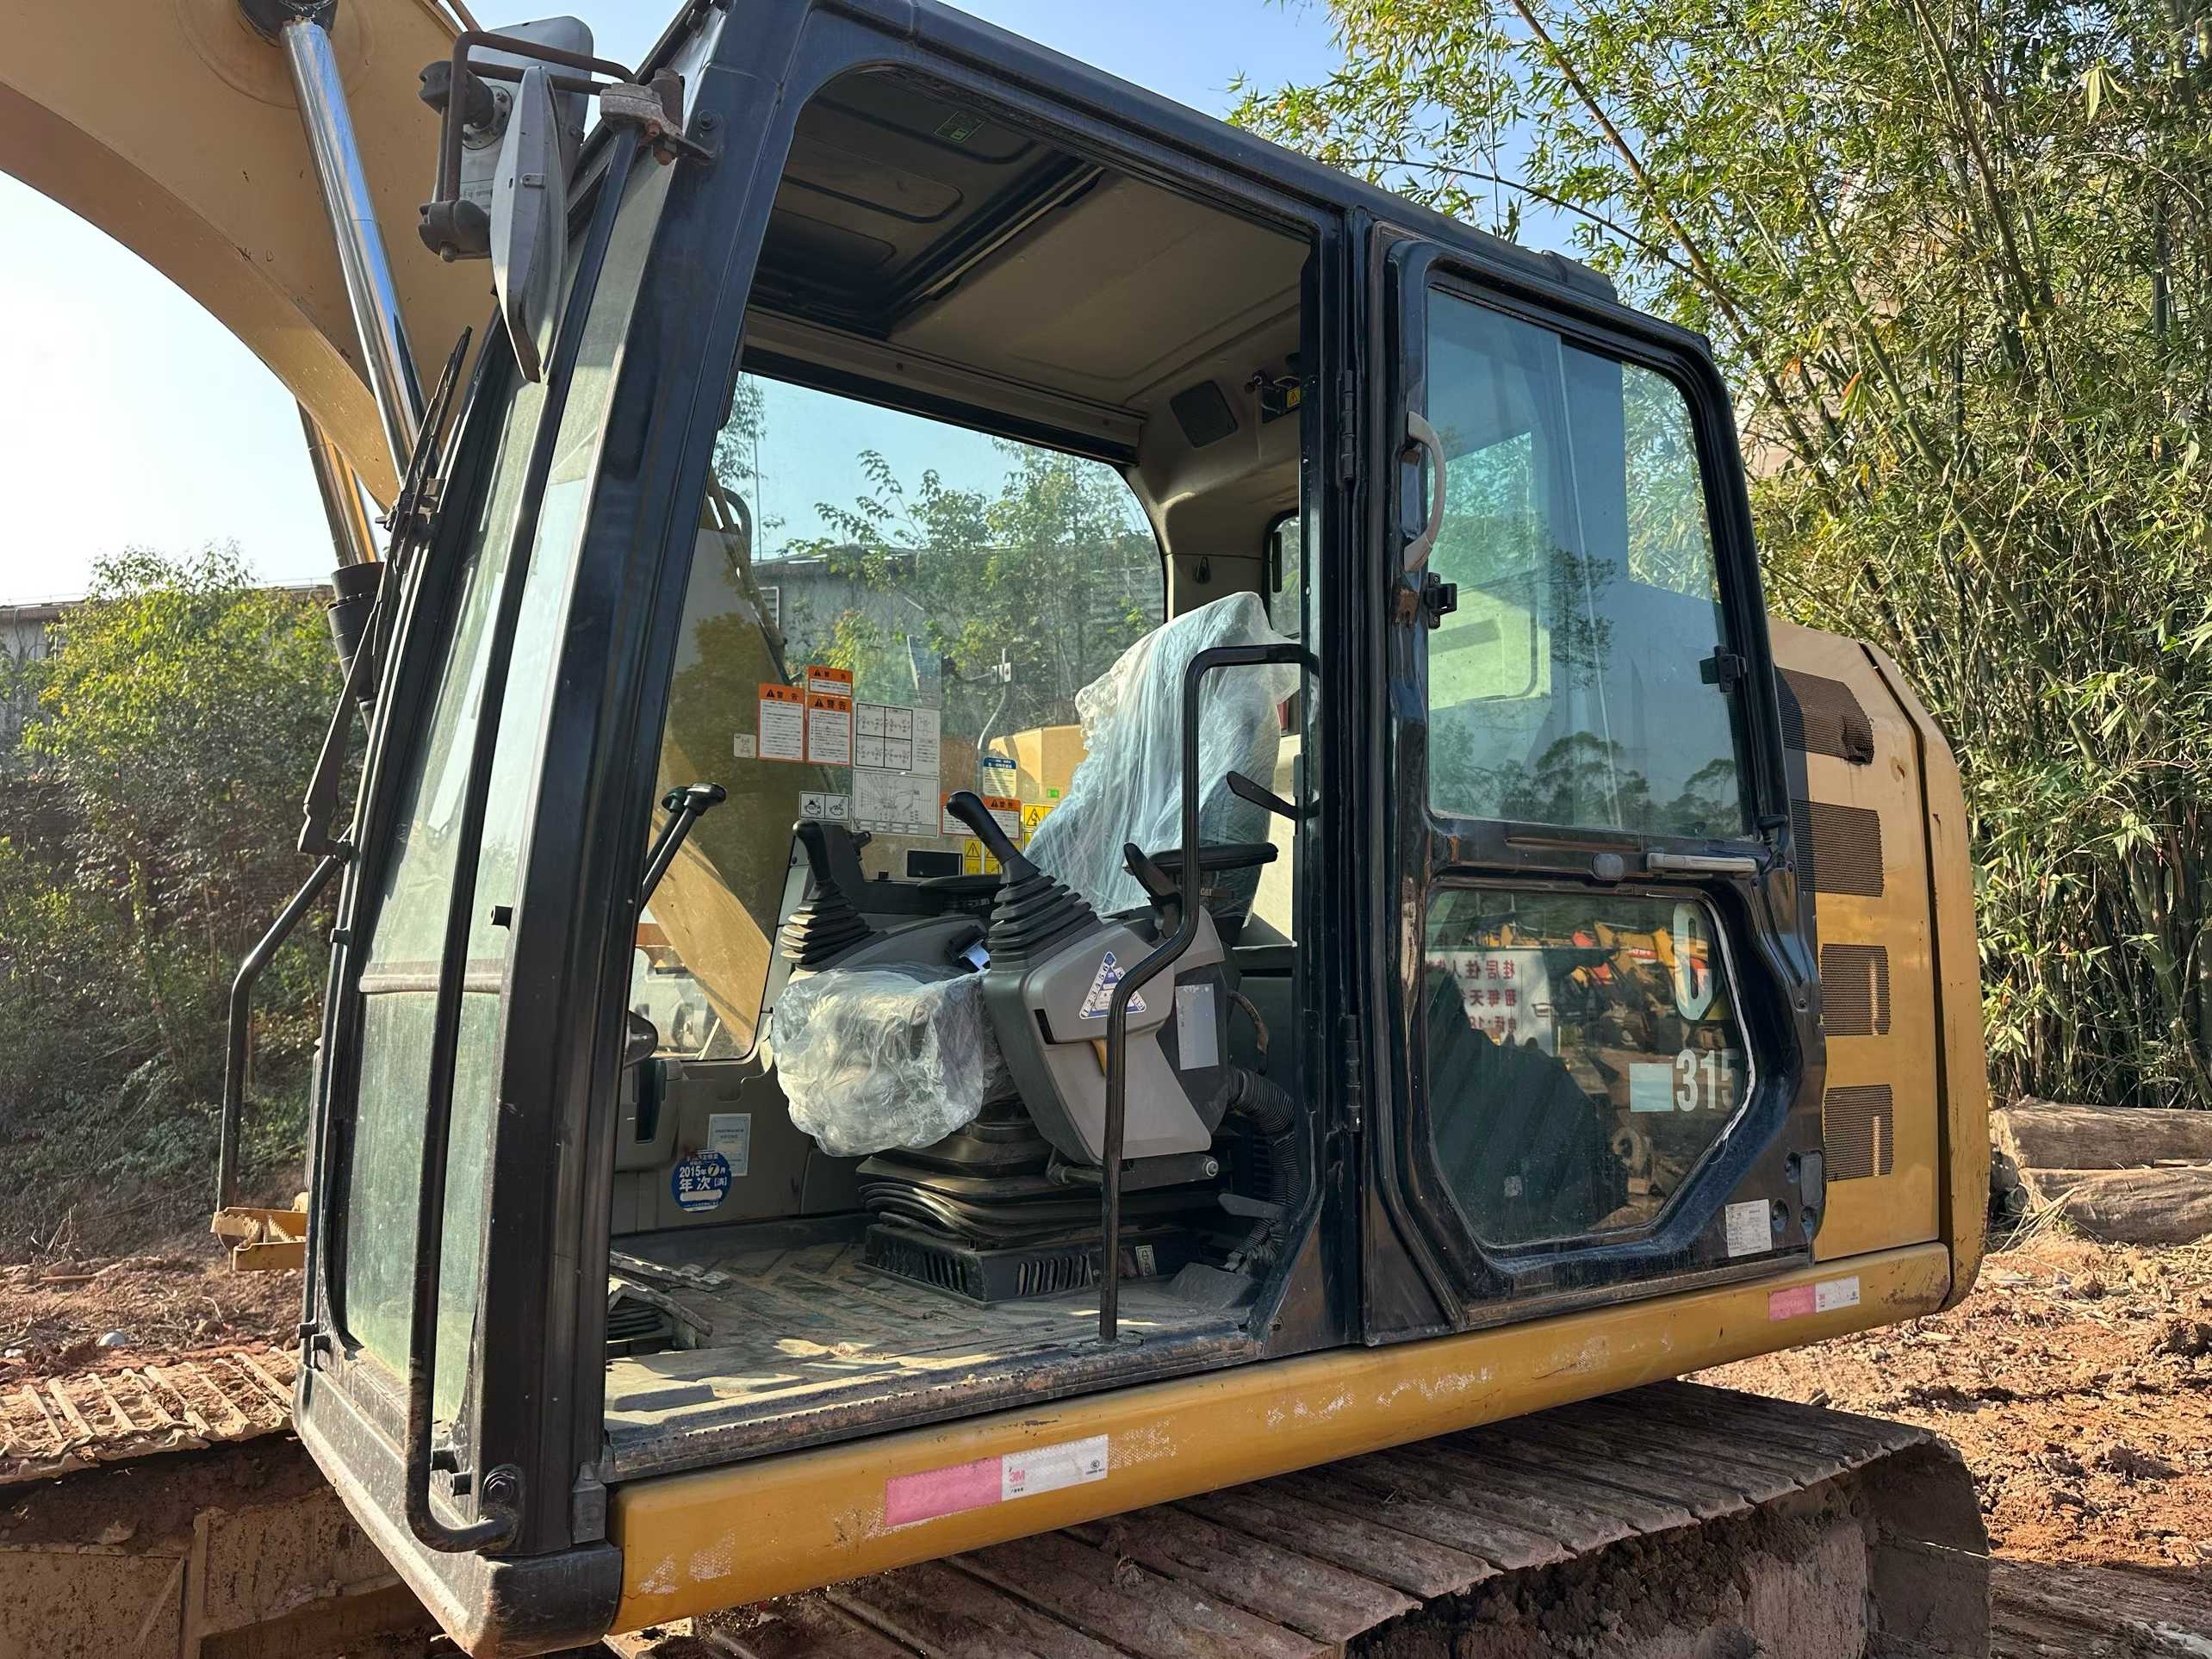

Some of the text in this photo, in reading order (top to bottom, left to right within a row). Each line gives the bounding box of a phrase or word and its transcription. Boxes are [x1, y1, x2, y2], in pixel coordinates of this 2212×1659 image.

[827, 699, 847, 711] 警告
[1675, 1048, 1740, 1113] 315
[1009, 1469, 1025, 1482] 3M
